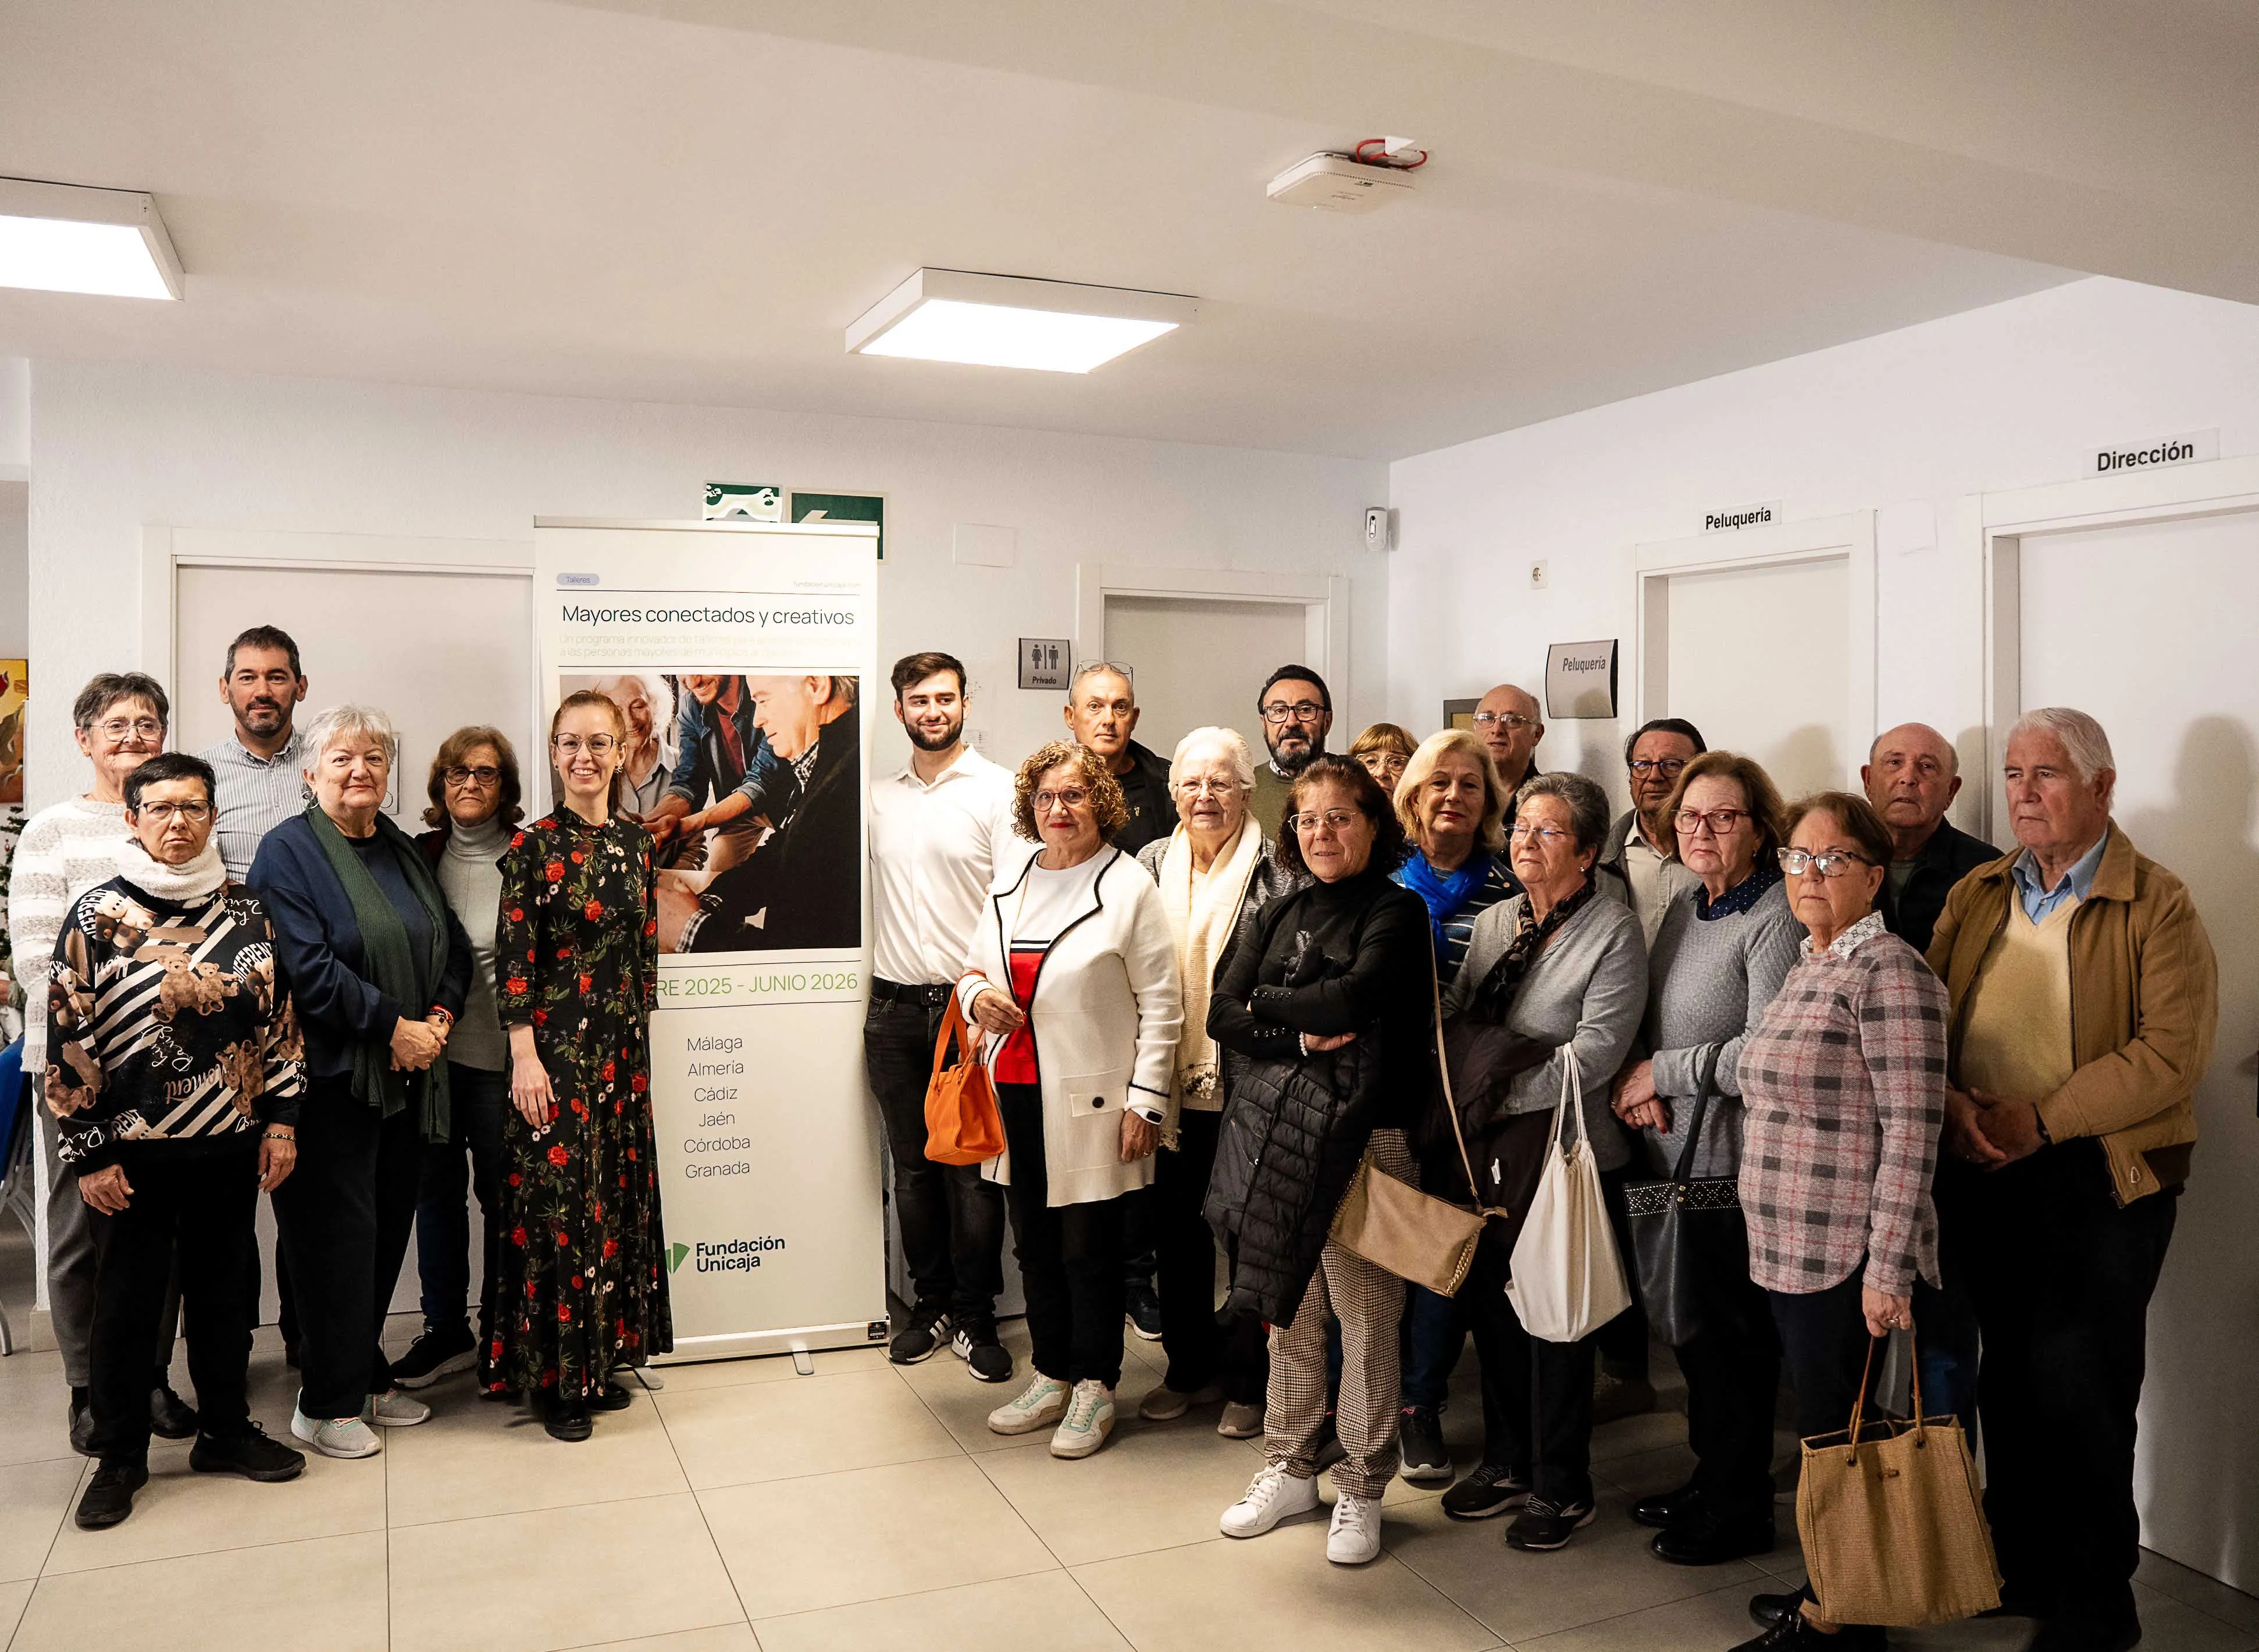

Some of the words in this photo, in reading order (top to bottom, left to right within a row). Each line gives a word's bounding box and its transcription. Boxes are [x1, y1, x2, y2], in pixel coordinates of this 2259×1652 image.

[2097, 441, 2193, 471] Dirección
[1706, 507, 1771, 529] Peluquería
[562, 605, 642, 626] Mayores
[646, 607, 755, 623] conectados
[758, 611, 769, 628] y
[772, 609, 854, 625] creativos
[559, 633, 573, 643] Un
[576, 635, 625, 646] programa
[679, 634, 692, 645] de
[583, 648, 632, 658] personas
[1562, 656, 1606, 674] Peluquería
[1032, 676, 1057, 684] Privado
[657, 980, 680, 996] RE
[685, 977, 732, 995] 2025
[749, 974, 806, 993] JUNIO
[811, 973, 858, 990] 2026
[687, 1036, 743, 1053] Málaga
[687, 1059, 744, 1077] Almería
[694, 1086, 738, 1102] Cádiz
[699, 1111, 735, 1127] Jaén
[684, 1137, 750, 1153] Córdoba
[685, 1161, 750, 1179] Granada
[696, 1236, 786, 1257] Fundación
[697, 1253, 761, 1273] Unicaja
